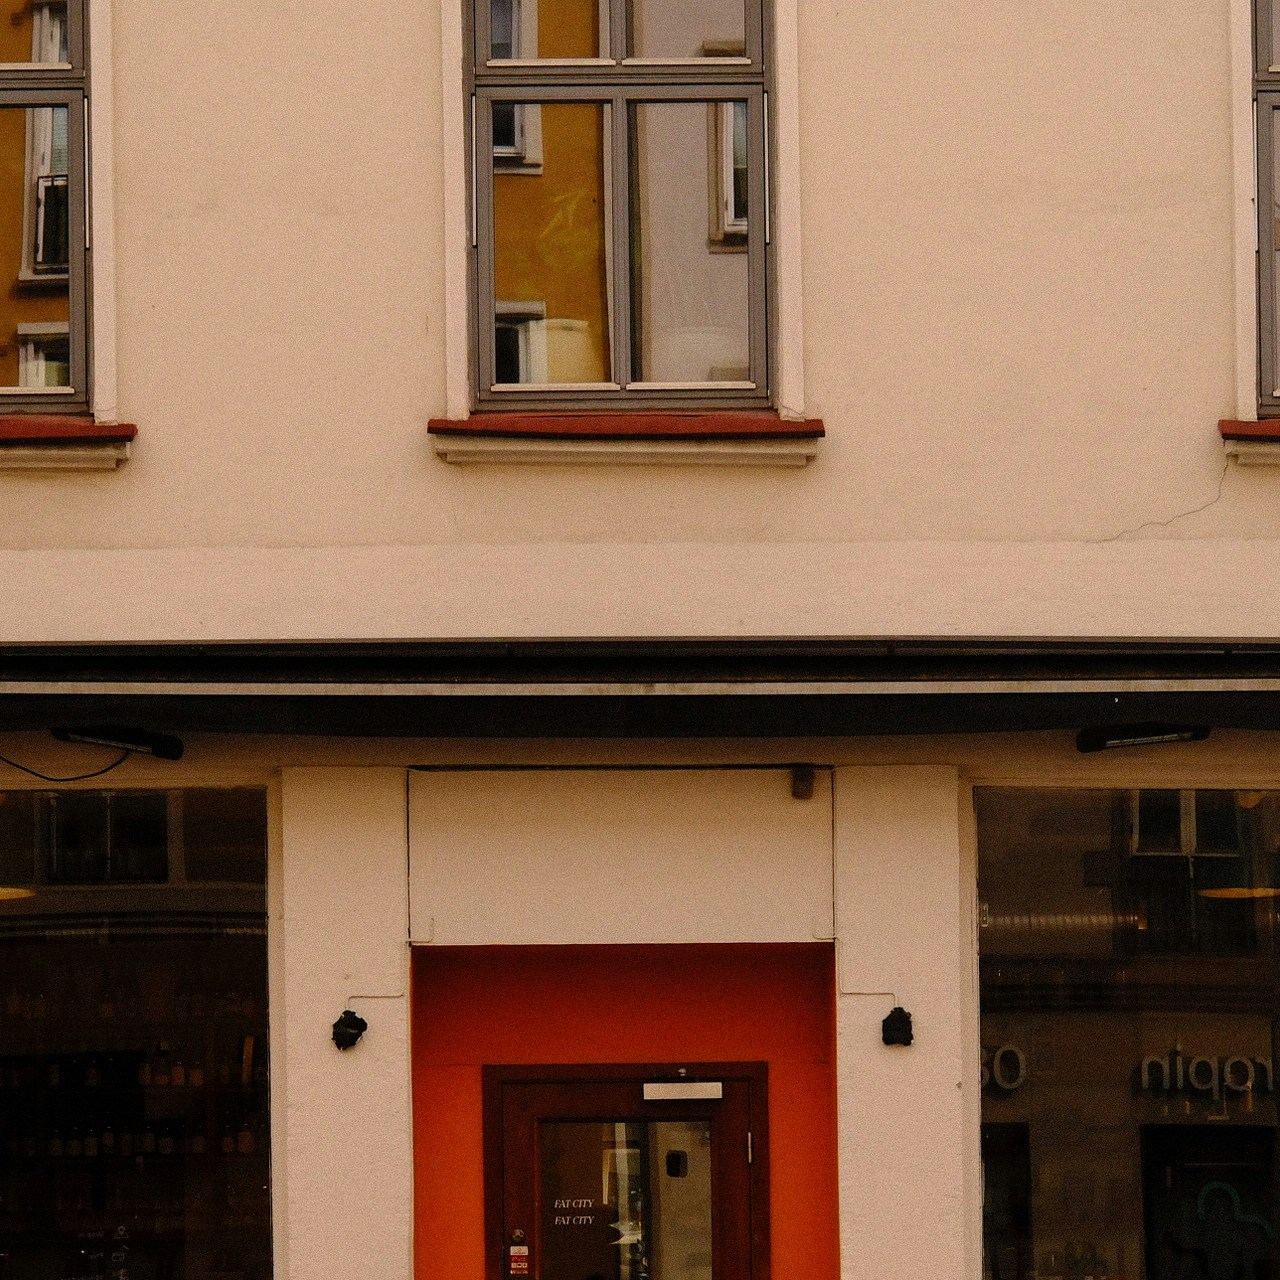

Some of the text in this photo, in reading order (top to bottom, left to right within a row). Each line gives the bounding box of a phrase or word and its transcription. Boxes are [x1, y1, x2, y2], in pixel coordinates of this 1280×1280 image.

[554, 1199, 595, 1208] FAT CITY
[554, 1216, 595, 1225] FAT CITY
